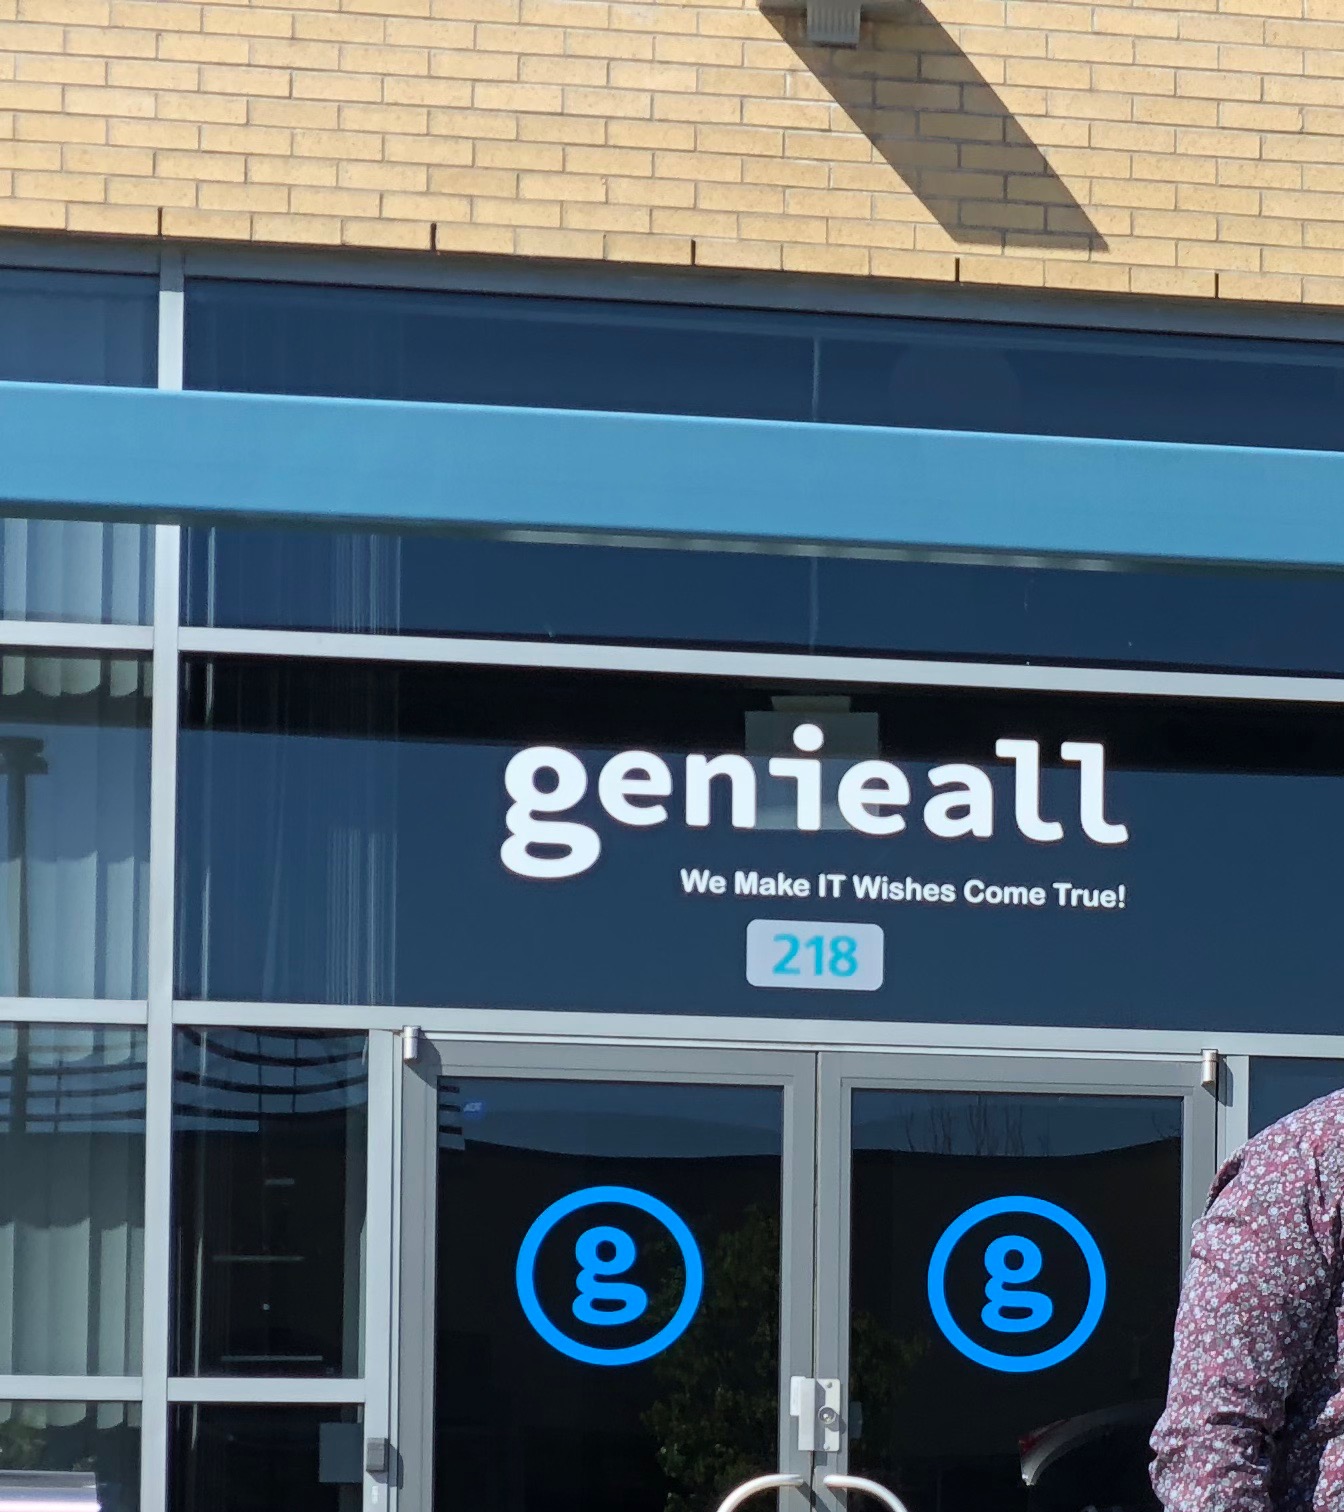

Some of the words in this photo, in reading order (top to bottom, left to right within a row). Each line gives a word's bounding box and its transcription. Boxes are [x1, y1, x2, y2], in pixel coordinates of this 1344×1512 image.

[499, 723, 1129, 879] genieall
[681, 868, 727, 895] We
[733, 871, 810, 899] Make
[817, 874, 848, 899] IT
[852, 874, 956, 904] Wishes
[962, 879, 1046, 907] Come
[1052, 881, 1127, 910] True!
[772, 932, 859, 978] 218
[571, 1225, 650, 1326] g
[980, 1235, 1054, 1333] g
